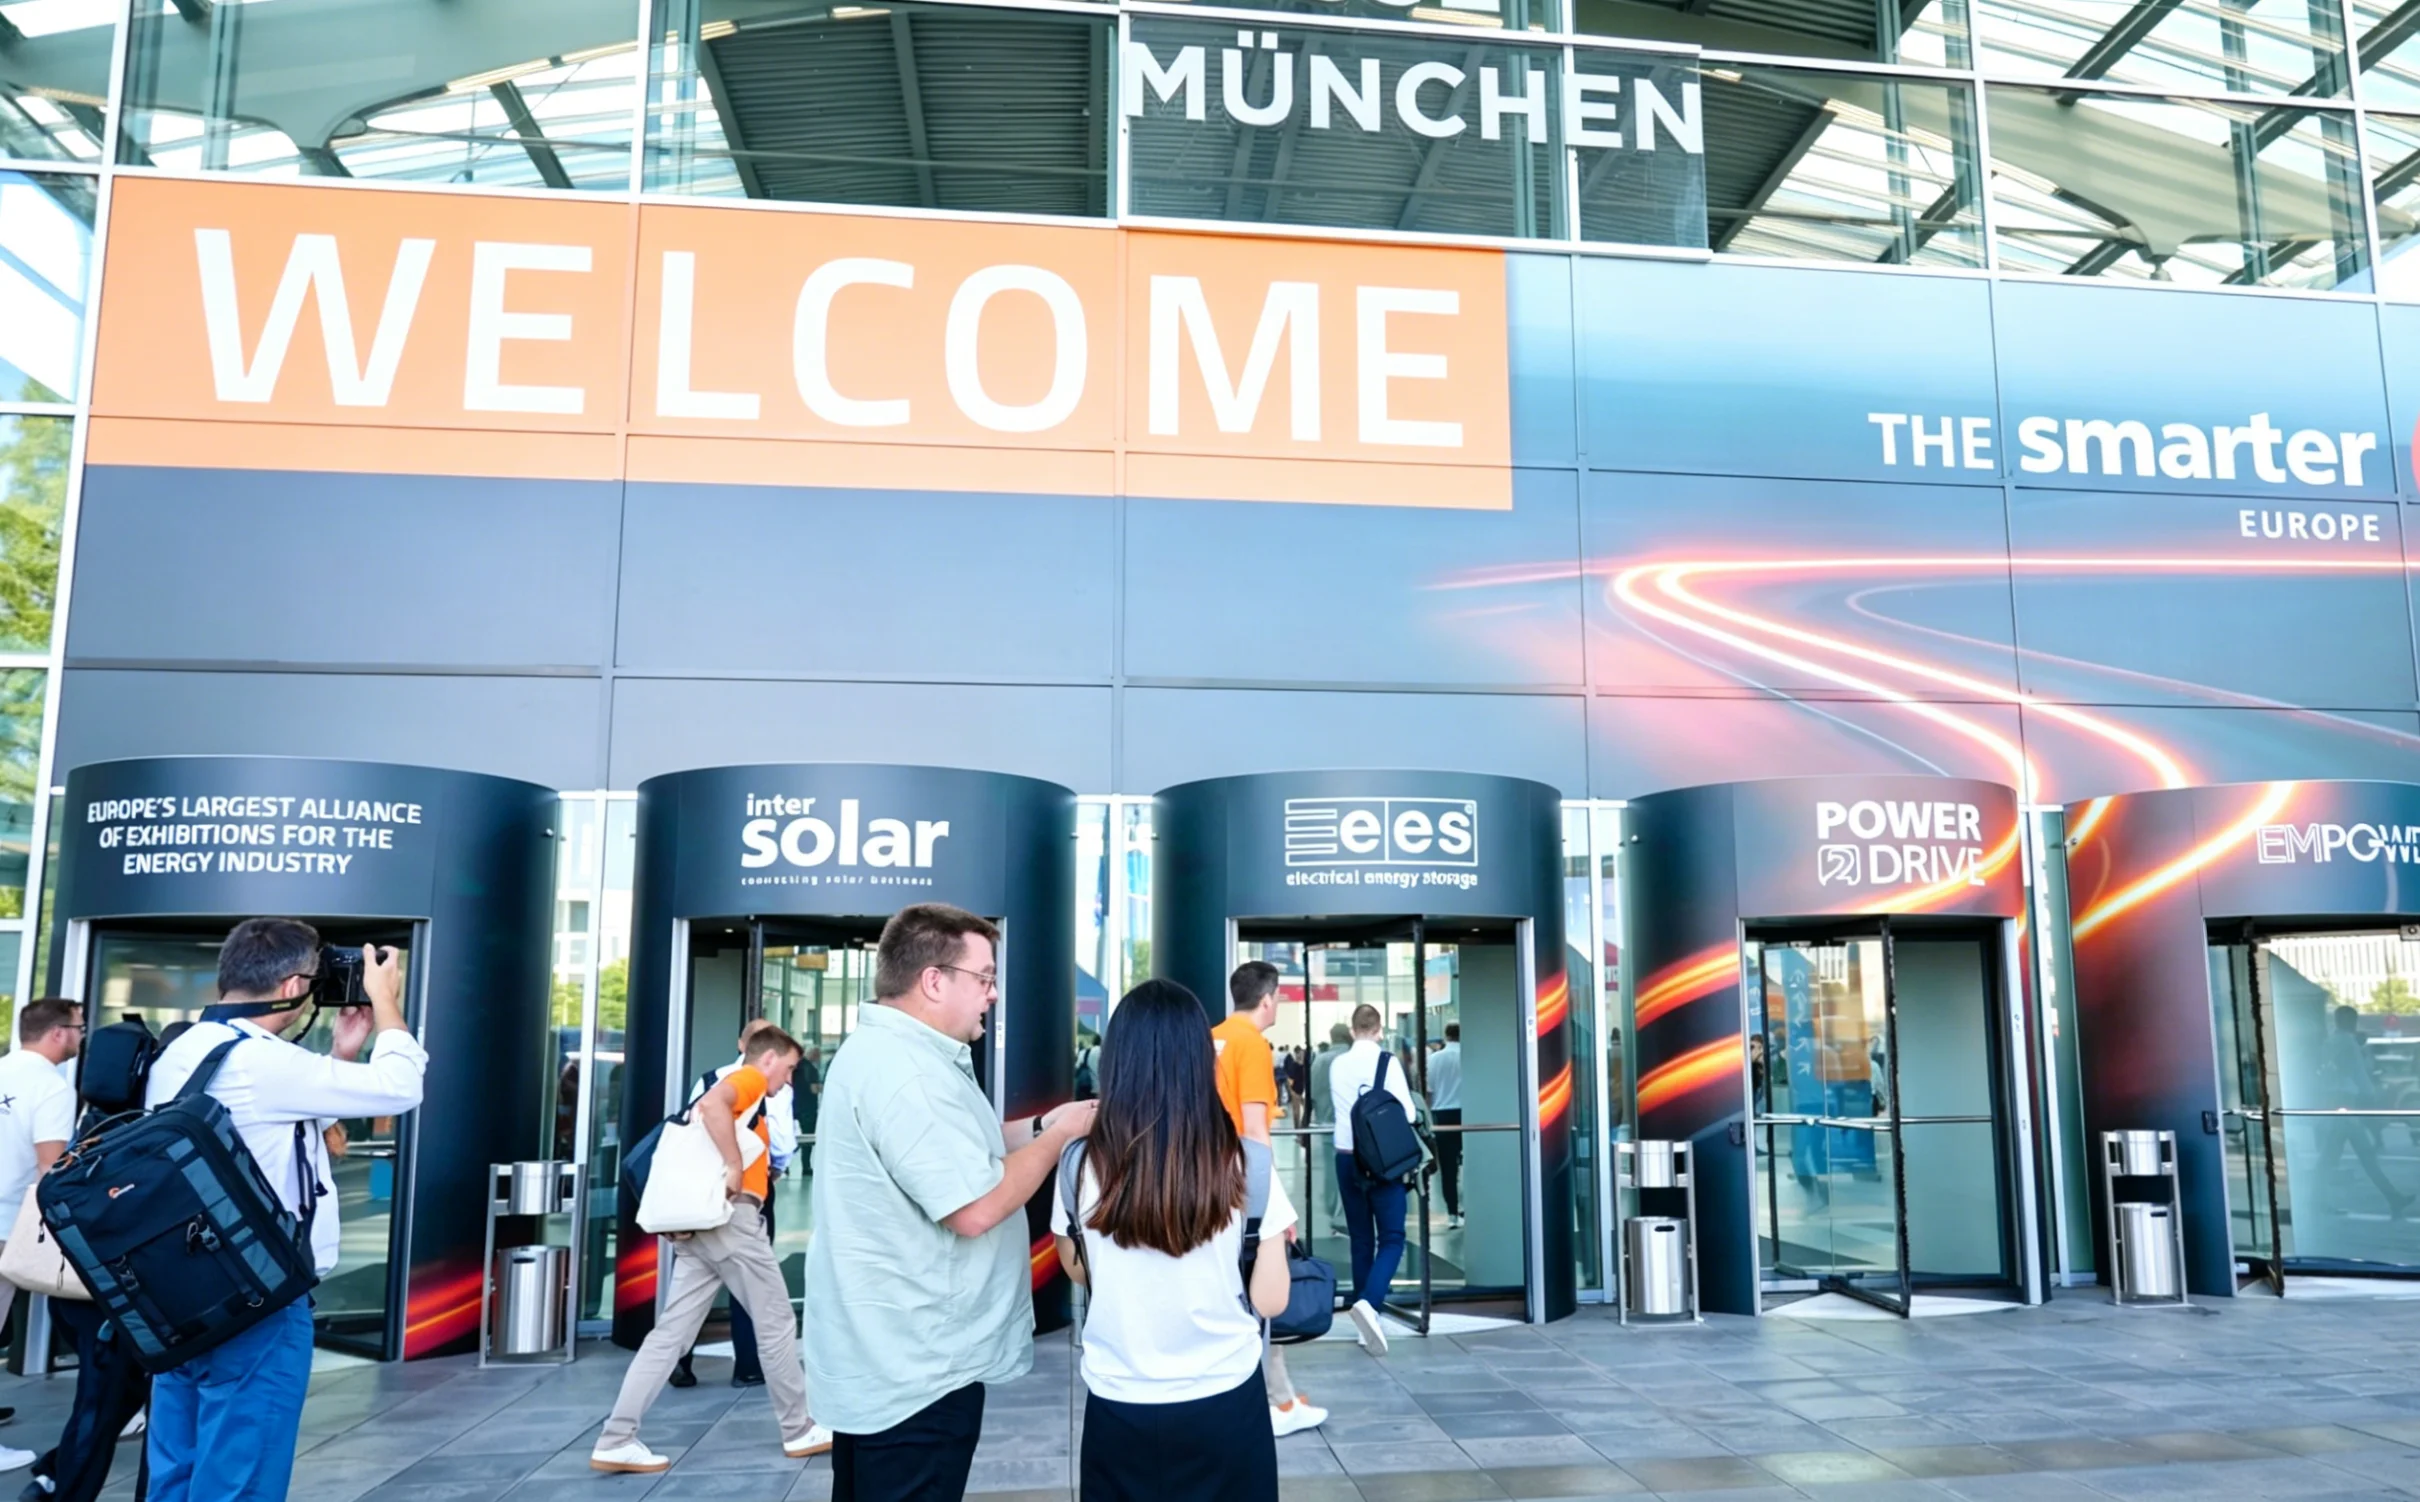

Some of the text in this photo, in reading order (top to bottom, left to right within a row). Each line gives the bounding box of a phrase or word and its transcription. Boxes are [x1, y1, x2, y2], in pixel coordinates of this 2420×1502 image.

[1126, 30, 1704, 154] MÜNCHEN
[195, 229, 1464, 448] WELCOME
[1868, 412, 2376, 486] THE smarter
[2239, 510, 2380, 542] EUROPE
[87, 797, 422, 824] EUROPE'S LARGEST ALLIANCE
[746, 793, 816, 816] inter
[1816, 800, 1982, 841] POWER
[99, 824, 393, 849] OF EXHIBITIONS FOR THE
[741, 799, 949, 867] solar
[123, 852, 353, 875] ENERGY INDUSTRY
[1422, 871, 1478, 890] storage
[1869, 844, 1985, 887] DRIVE
